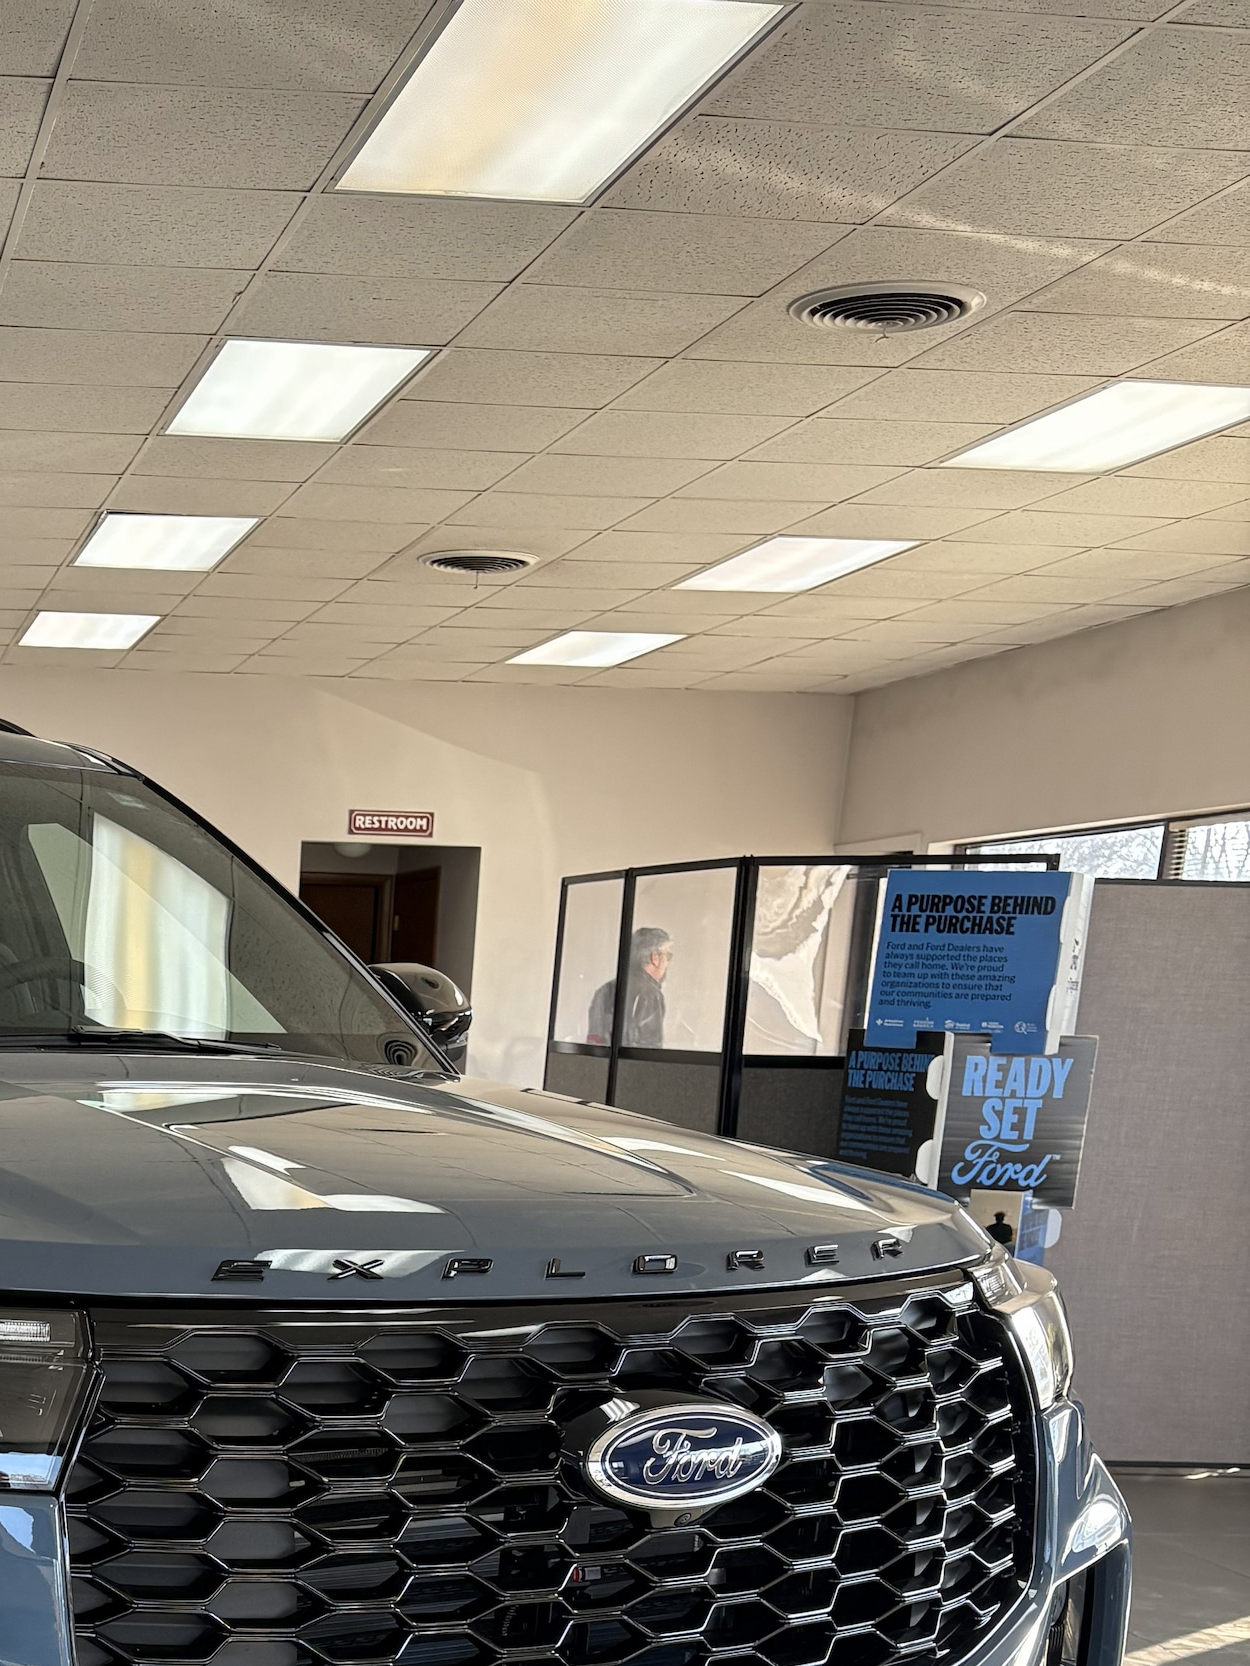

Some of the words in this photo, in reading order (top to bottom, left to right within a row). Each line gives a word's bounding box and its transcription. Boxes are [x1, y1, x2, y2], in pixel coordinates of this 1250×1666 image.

[355, 815, 428, 831] RESTROOM
[891, 894, 903, 912] A
[906, 894, 988, 914] PURPOSE
[989, 895, 1056, 915] BEHIND
[890, 914, 922, 933] THE
[924, 915, 1017, 935] PURCHASE
[886, 941, 906, 950] Ford
[907, 943, 924, 951] and
[925, 942, 946, 951] Ford
[947, 943, 981, 952] Dealers
[982, 944, 1005, 953] have
[884, 961, 903, 970] they
[904, 962, 920, 970] call
[921, 962, 949, 970] home.
[951, 963, 976, 971] We're
[977, 964, 1005, 973] proud
[885, 952, 914, 961] always
[916, 953, 961, 962] supported
[979, 955, 1008, 963] places
[881, 980, 940, 989] organizations
[952, 983, 983, 991] ensure
[985, 983, 1003, 991] that
[882, 970, 891, 978] to
[893, 971, 915, 979] team
[917, 972, 929, 981] up
[930, 972, 950, 980] with
[951, 973, 976, 981] these
[977, 974, 1016, 984] amazing
[878, 998, 895, 1006] and
[897, 999, 932, 1009] thriving.
[896, 989, 953, 999] communities
[970, 993, 1012, 1002] prepared
[848, 1051, 856, 1068] A
[857, 1051, 901, 1071] PURPOSE
[847, 1069, 866, 1088] THE
[865, 1071, 916, 1092] PURCHASE
[962, 1055, 1073, 1098] READY
[979, 1098, 1043, 1140] SET
[951, 1140, 1052, 1187] Ford
[211, 1238, 903, 1282] EXPLORER
[643, 1427, 743, 1484] Ford
